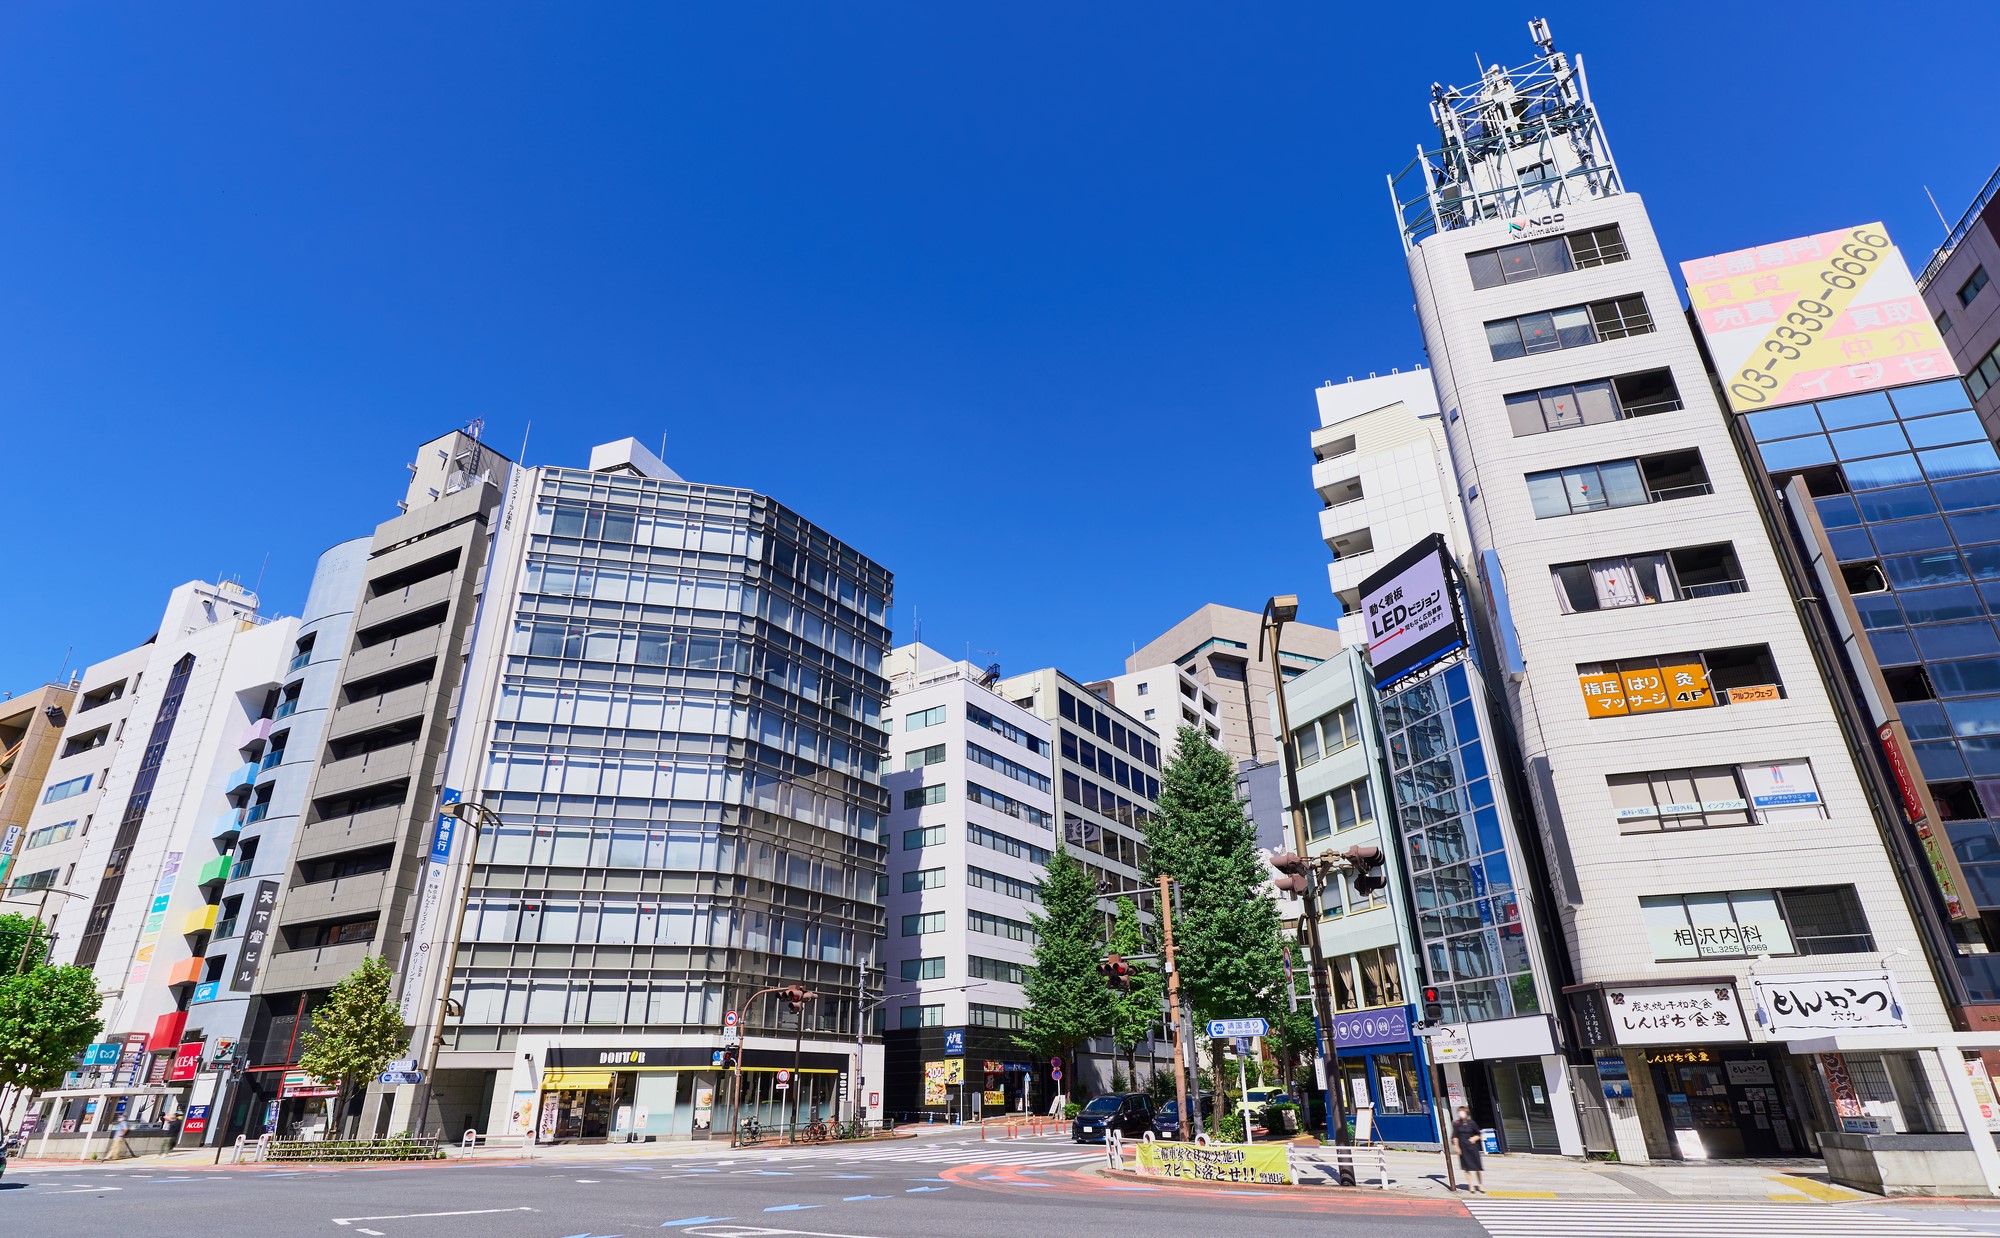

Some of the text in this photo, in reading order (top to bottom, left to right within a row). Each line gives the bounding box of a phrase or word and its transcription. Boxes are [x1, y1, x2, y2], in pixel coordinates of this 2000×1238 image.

[1693, 239, 1823, 281] 店舗専門
[1703, 273, 1784, 304] 賃貸
[1714, 300, 1778, 329] 売買
[1731, 229, 1889, 403] 03-3339-6666
[1850, 301, 1920, 330] 買取
[1840, 329, 1925, 360] 仲介
[1801, 356, 1938, 393] イワセ
[1368, 586, 1404, 617] 動く看板
[1372, 589, 1440, 639] LEDビジョン
[1404, 604, 1443, 631] 間もなく広告募集
[1584, 672, 1695, 696] 指圧 はり 灸
[1731, 689, 1775, 701] アルファウェーブ
[1598, 690, 1704, 710] マッサージ 4F
[1666, 804, 1694, 813] 口腔外科
[1706, 800, 1743, 810] インプラント
[240, 890, 273, 982] 天下堂ビル
[1674, 925, 1762, 946] 相沢内科
[1772, 988, 1888, 1017] とんかつ
[1228, 1020, 1259, 1029] 靖国通り
[1623, 1011, 1731, 1030] しんぱち食堂
[600, 1051, 646, 1063] DOUTOR
[186, 1121, 204, 1129] ACCEA
[1164, 1163, 1256, 1183] スピード落とせ!!
[1259, 1172, 1285, 1184] 警視庁
